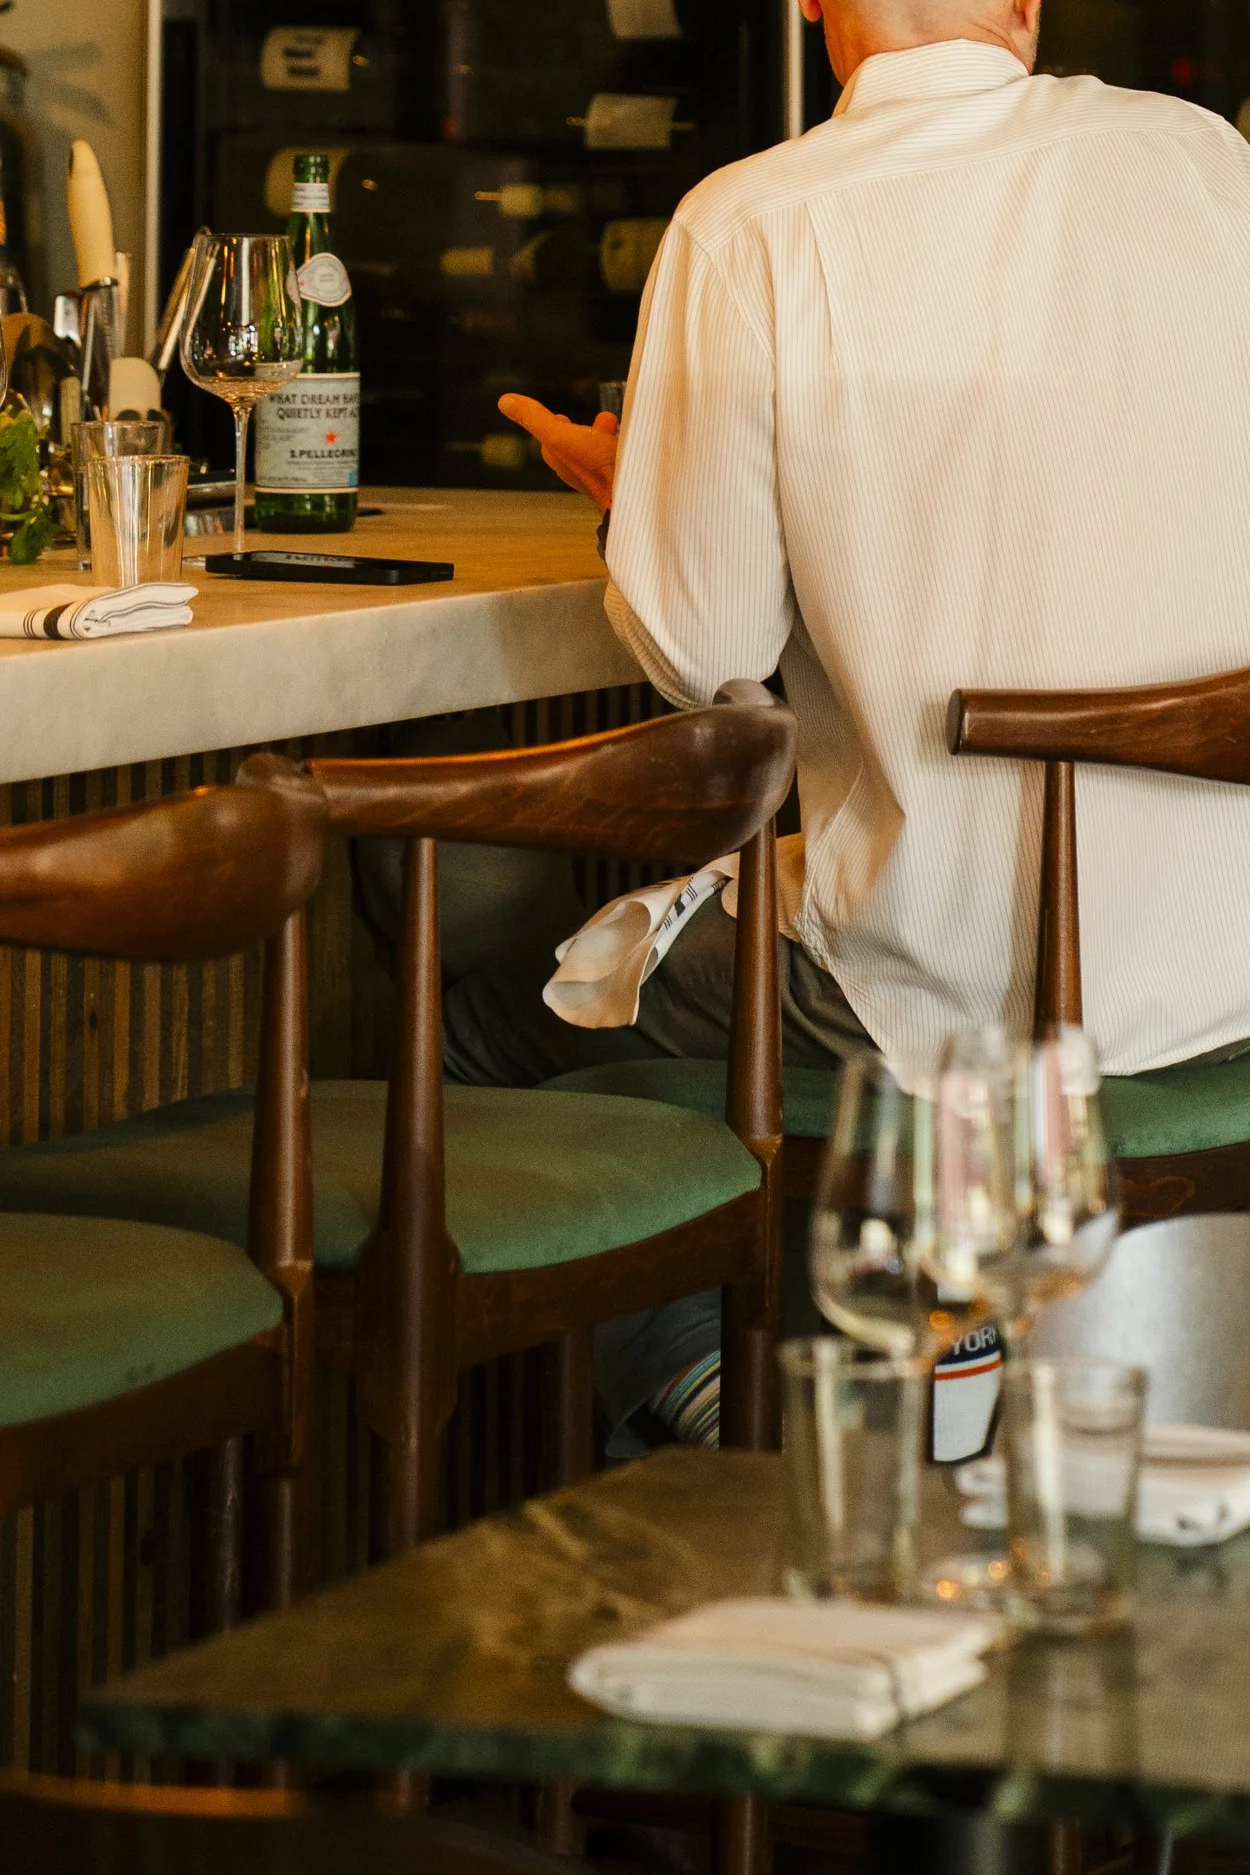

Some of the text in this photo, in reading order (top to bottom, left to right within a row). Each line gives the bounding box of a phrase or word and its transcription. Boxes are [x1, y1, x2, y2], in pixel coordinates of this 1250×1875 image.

[269, 393, 297, 404] WHAT
[301, 393, 340, 404] DREAM
[277, 407, 320, 420] QUIETLY
[325, 407, 348, 419] KEPT
[289, 449, 359, 459] S.PELLEGRIN
